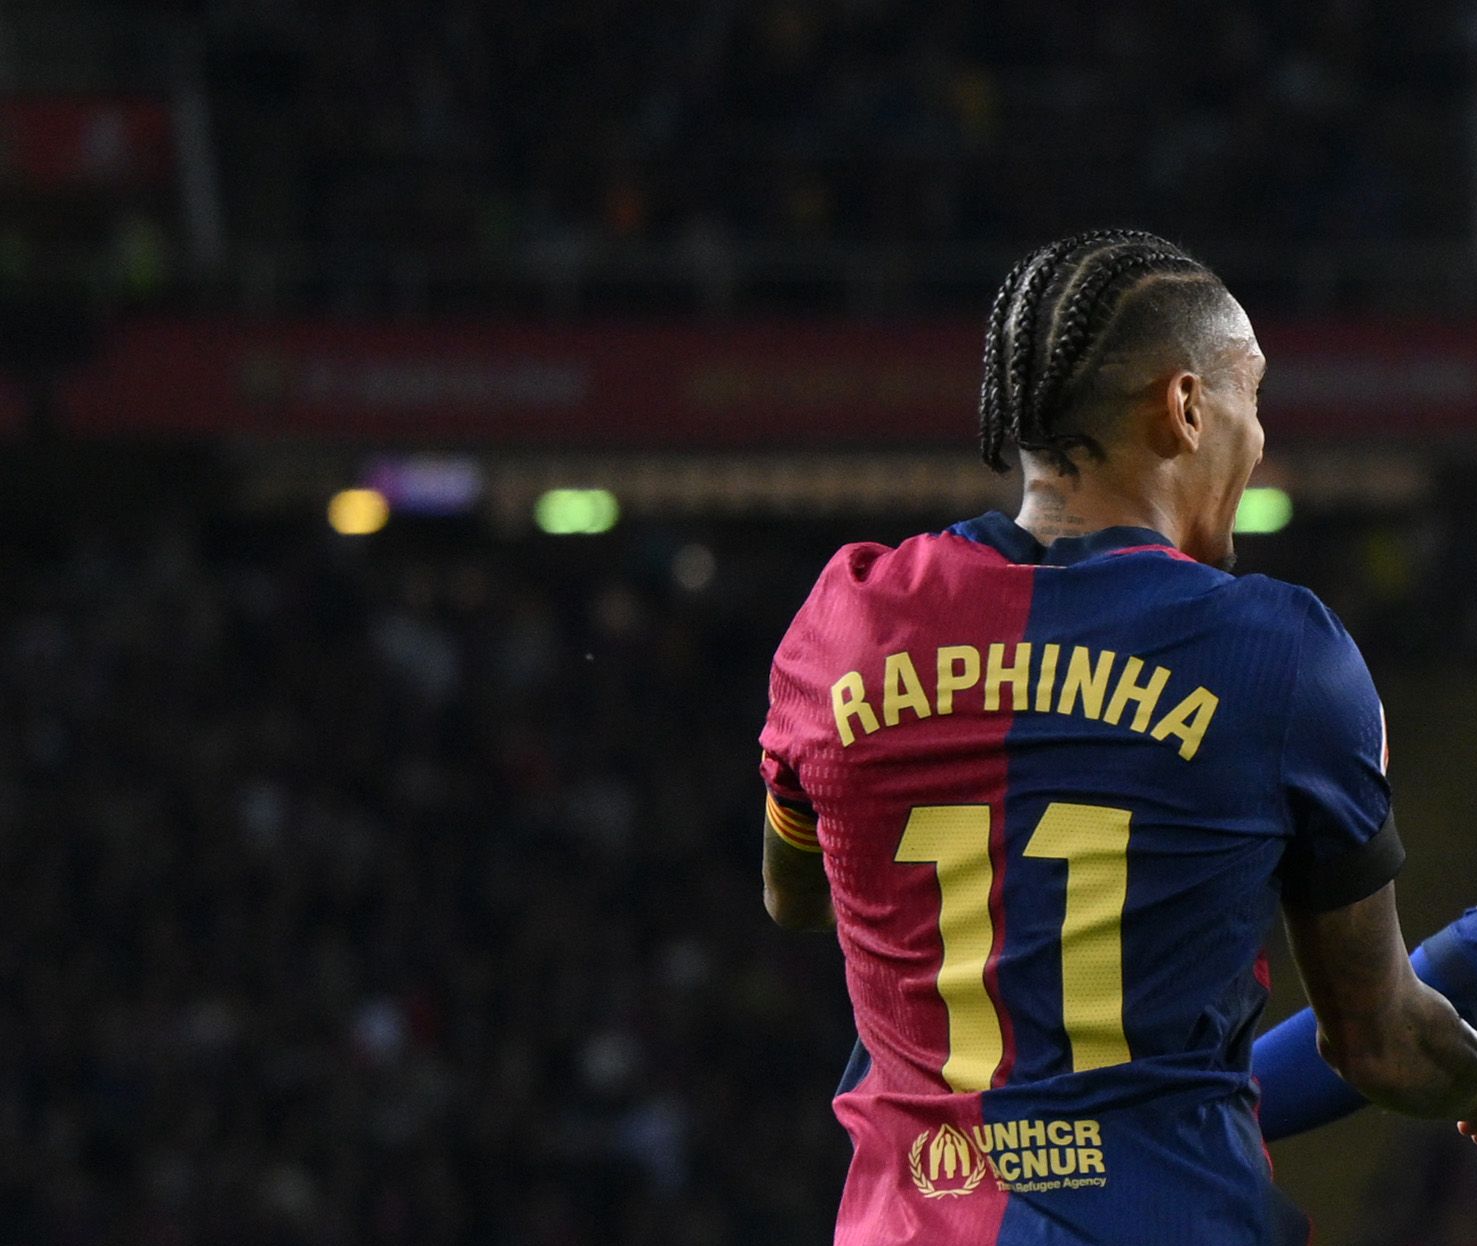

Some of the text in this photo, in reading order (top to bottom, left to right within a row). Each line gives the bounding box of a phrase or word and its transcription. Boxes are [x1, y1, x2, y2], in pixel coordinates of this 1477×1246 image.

[830, 641, 1220, 762] RAPHINHA
[893, 801, 1133, 1093] 11
[972, 1119, 1102, 1154] UNHCR
[1063, 1177, 1107, 1190] Agency
